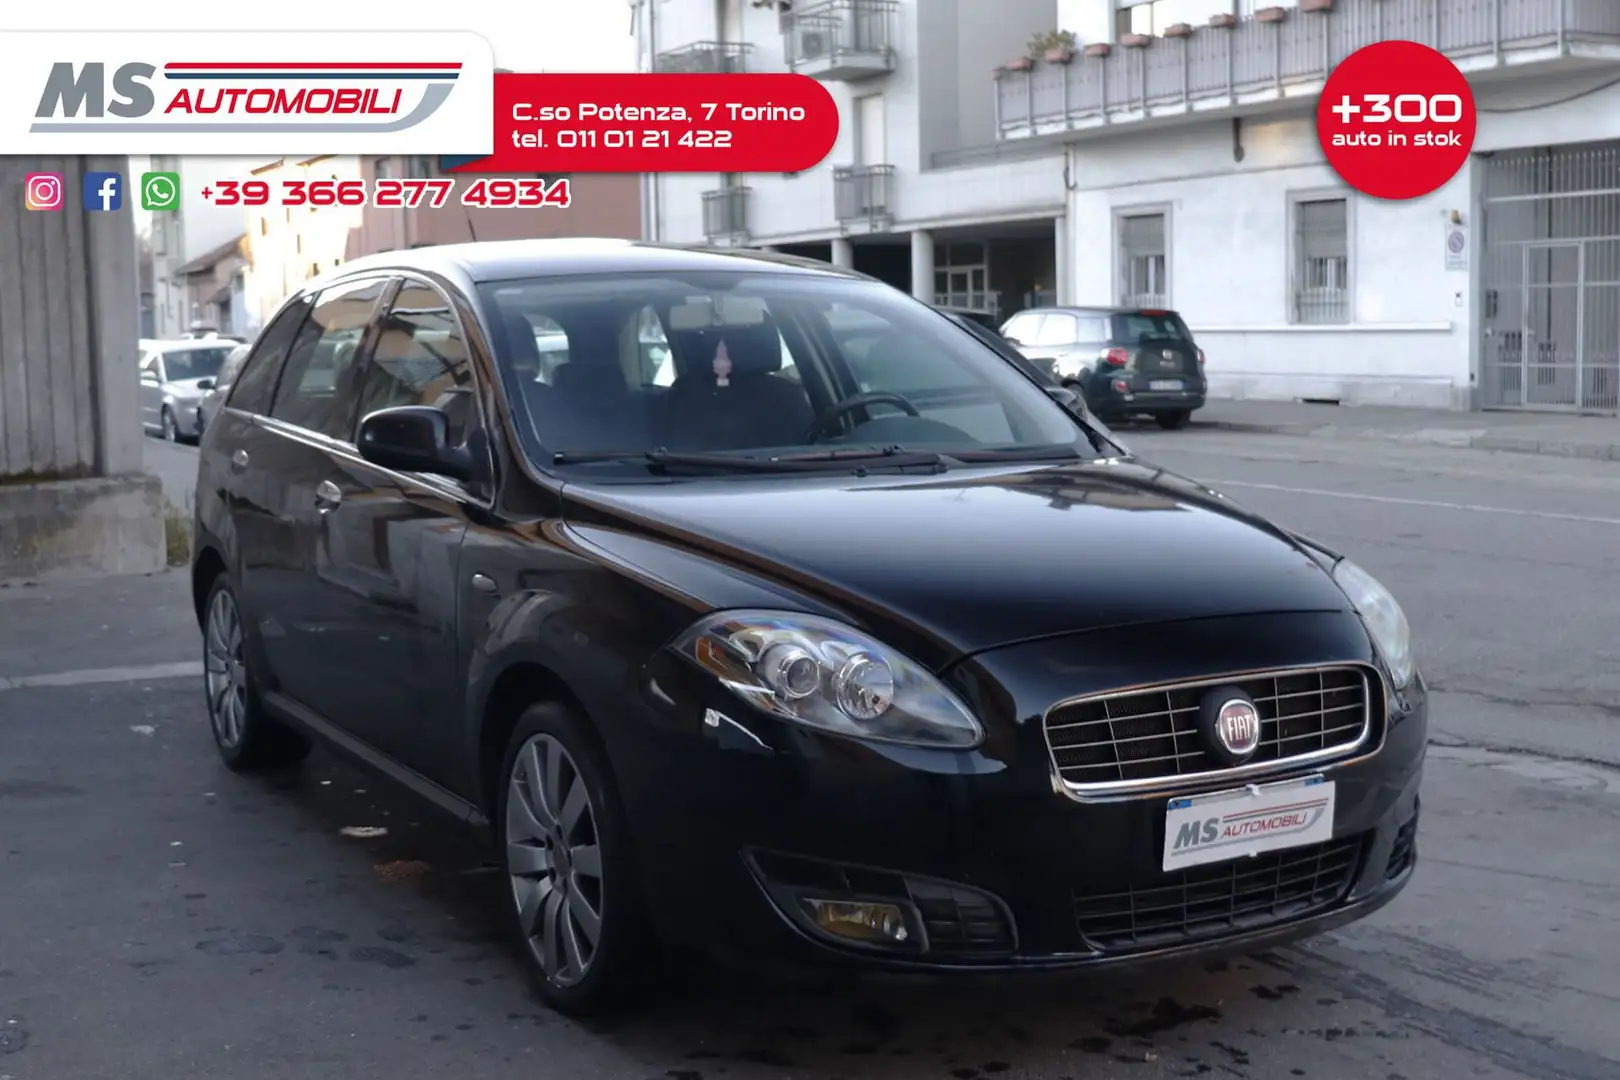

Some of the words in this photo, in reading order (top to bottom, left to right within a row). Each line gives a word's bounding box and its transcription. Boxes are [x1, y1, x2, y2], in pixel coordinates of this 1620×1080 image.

[1227, 714, 1250, 741] FIAT
[1173, 817, 1220, 850] MS
[1222, 812, 1308, 837] AUTOMOBILI
